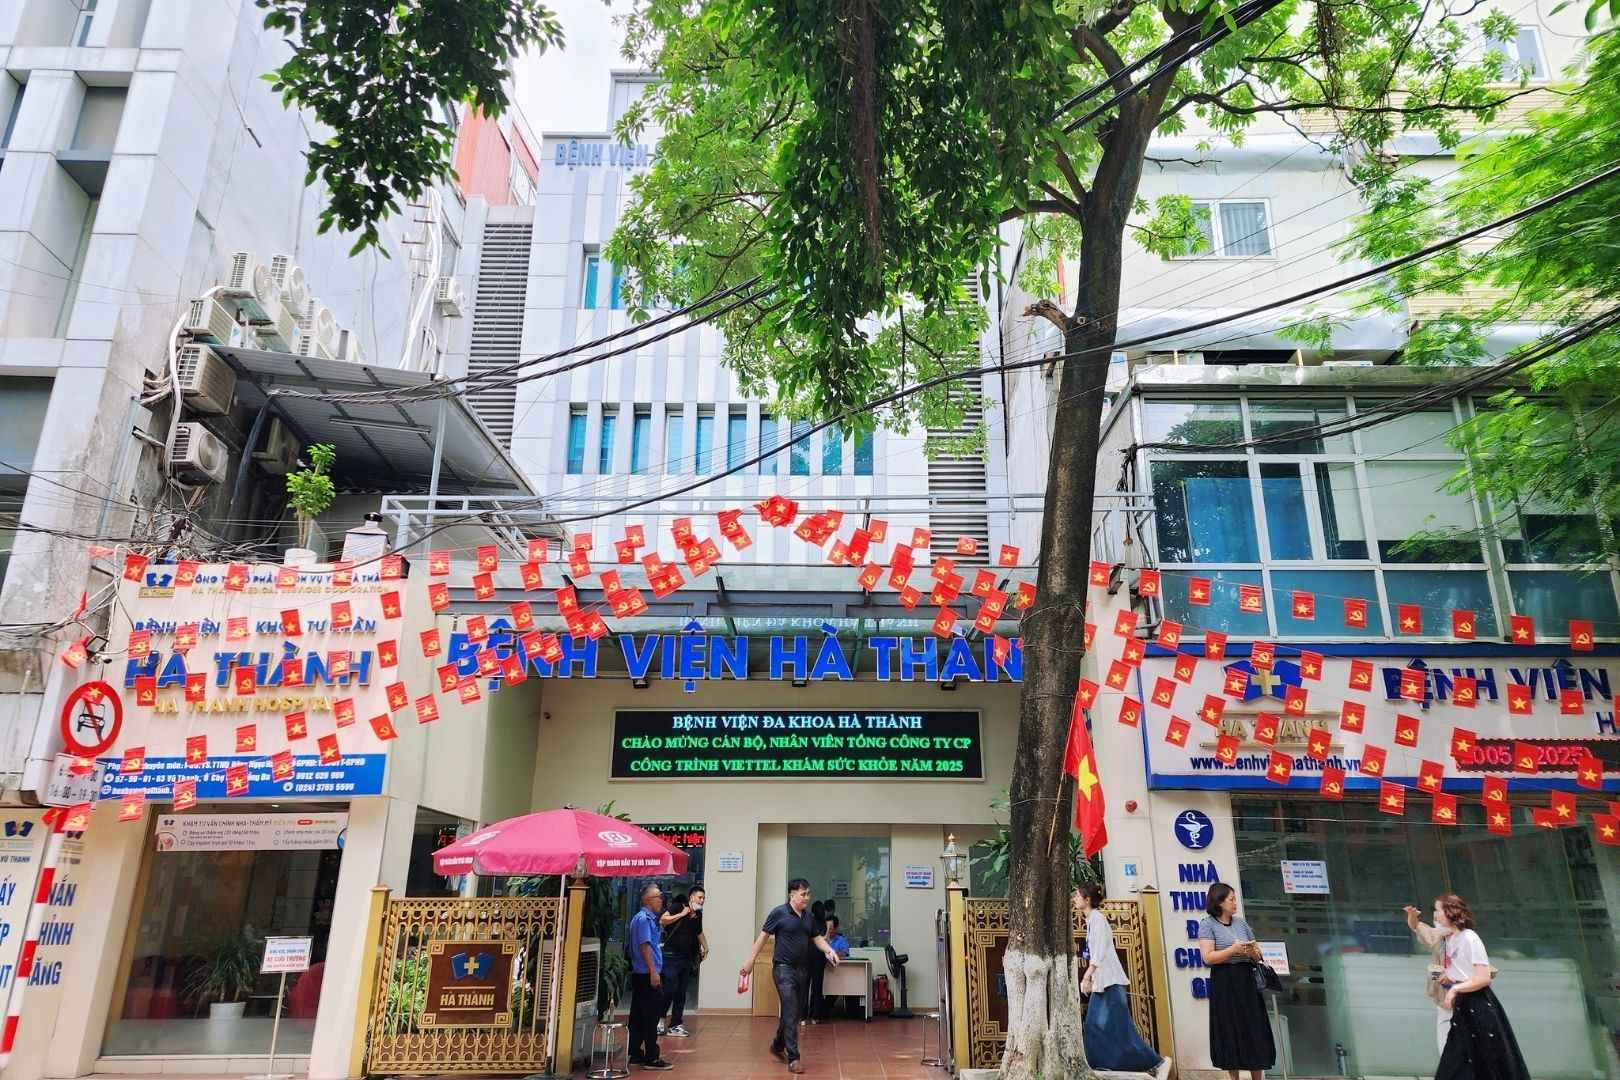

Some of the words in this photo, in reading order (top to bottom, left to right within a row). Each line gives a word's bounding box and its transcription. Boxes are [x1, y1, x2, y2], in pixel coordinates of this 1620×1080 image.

[555, 138, 603, 170] BỆNH
[618, 619, 748, 693] VIỆN
[769, 622, 854, 681] HÀ
[868, 624, 1024, 682] THÀN
[1381, 657, 1499, 712] BỆNH
[672, 714, 717, 731] BỆNH
[722, 714, 759, 731] VIỆN
[763, 716, 785, 729] ĐA
[788, 716, 835, 729] KHOA
[838, 713, 862, 729] HÀ
[865, 713, 922, 729] THÀNH
[622, 735, 662, 749] CHÀO
[665, 734, 709, 749] MỪNG
[712, 735, 741, 749] CÁN
[743, 735, 767, 751] BỘ,
[770, 734, 808, 749] NHÂN
[811, 734, 844, 749] VIÊN
[890, 734, 930, 749] CÔNG
[934, 737, 952, 749] TY
[953, 737, 972, 749] CP
[630, 757, 672, 771] CÔNG
[675, 757, 719, 771] TRÌNH
[722, 759, 781, 771] VIETTEL
[783, 757, 825, 771] KHÁM
[827, 757, 856, 771] SỨC
[858, 756, 898, 771] KHỎE
[901, 757, 933, 771] NĂM
[936, 760, 964, 771] 2025
[1472, 746, 1513, 765] 005
[1178, 860, 1220, 883] NHÀ
[1169, 891, 1207, 911] THU
[38, 913, 74, 946] HỈNH
[28, 958, 62, 987] ĂNG
[440, 991, 456, 1006] HÀ
[458, 991, 495, 1006] THÀNH
